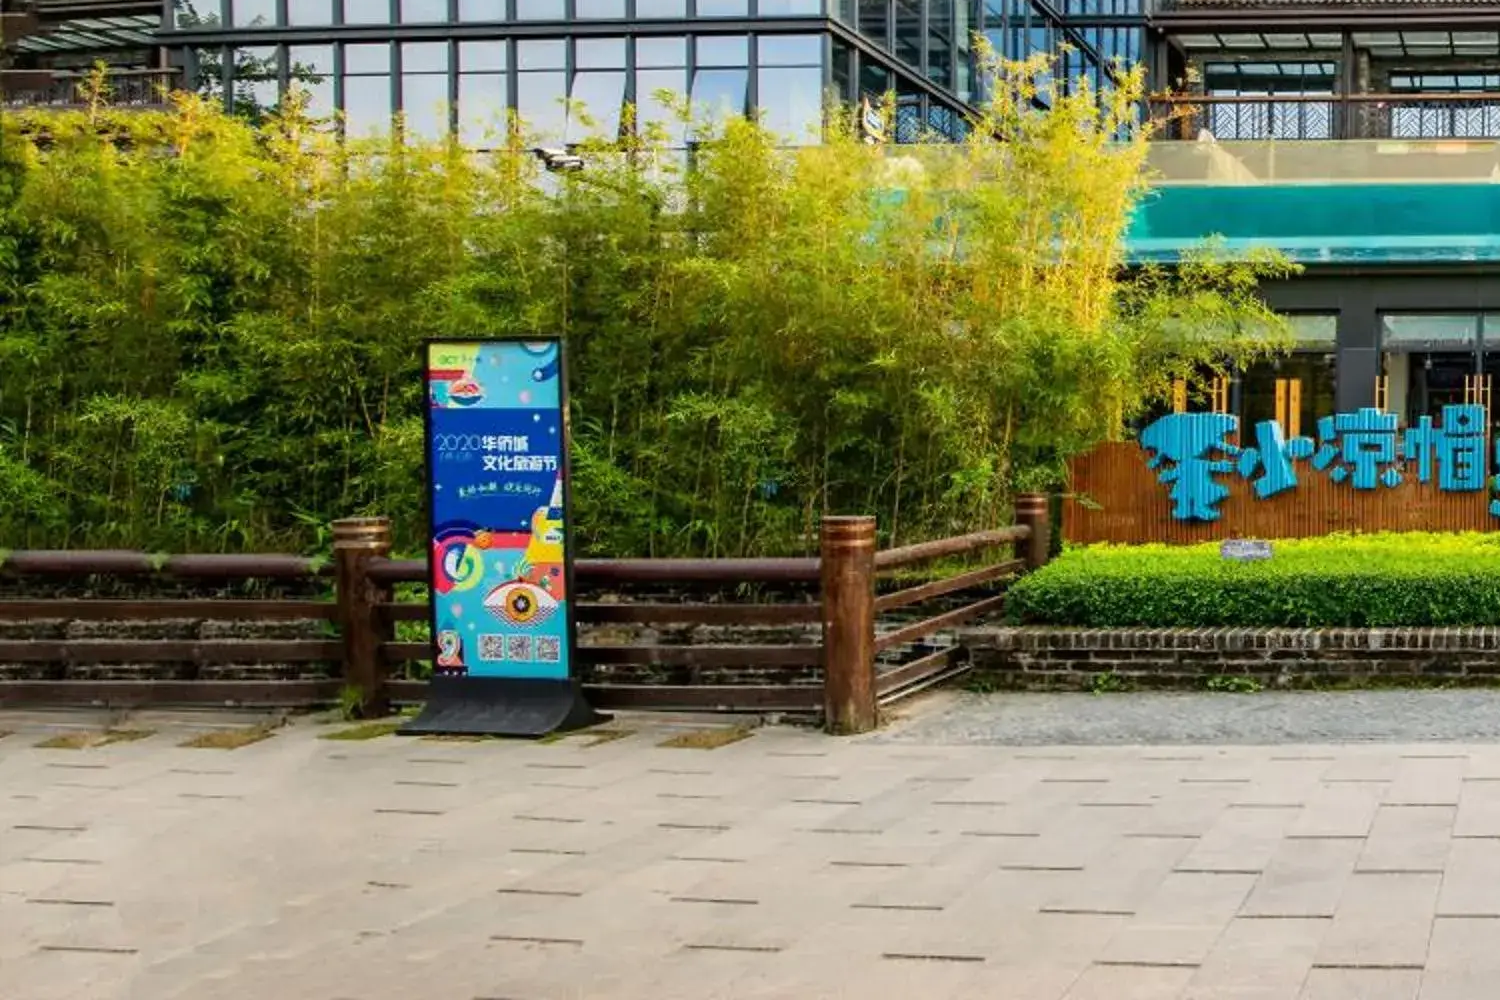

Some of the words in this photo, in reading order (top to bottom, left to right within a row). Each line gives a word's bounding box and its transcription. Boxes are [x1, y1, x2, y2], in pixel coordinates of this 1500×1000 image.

[482, 455, 557, 471] 文化旅游节
